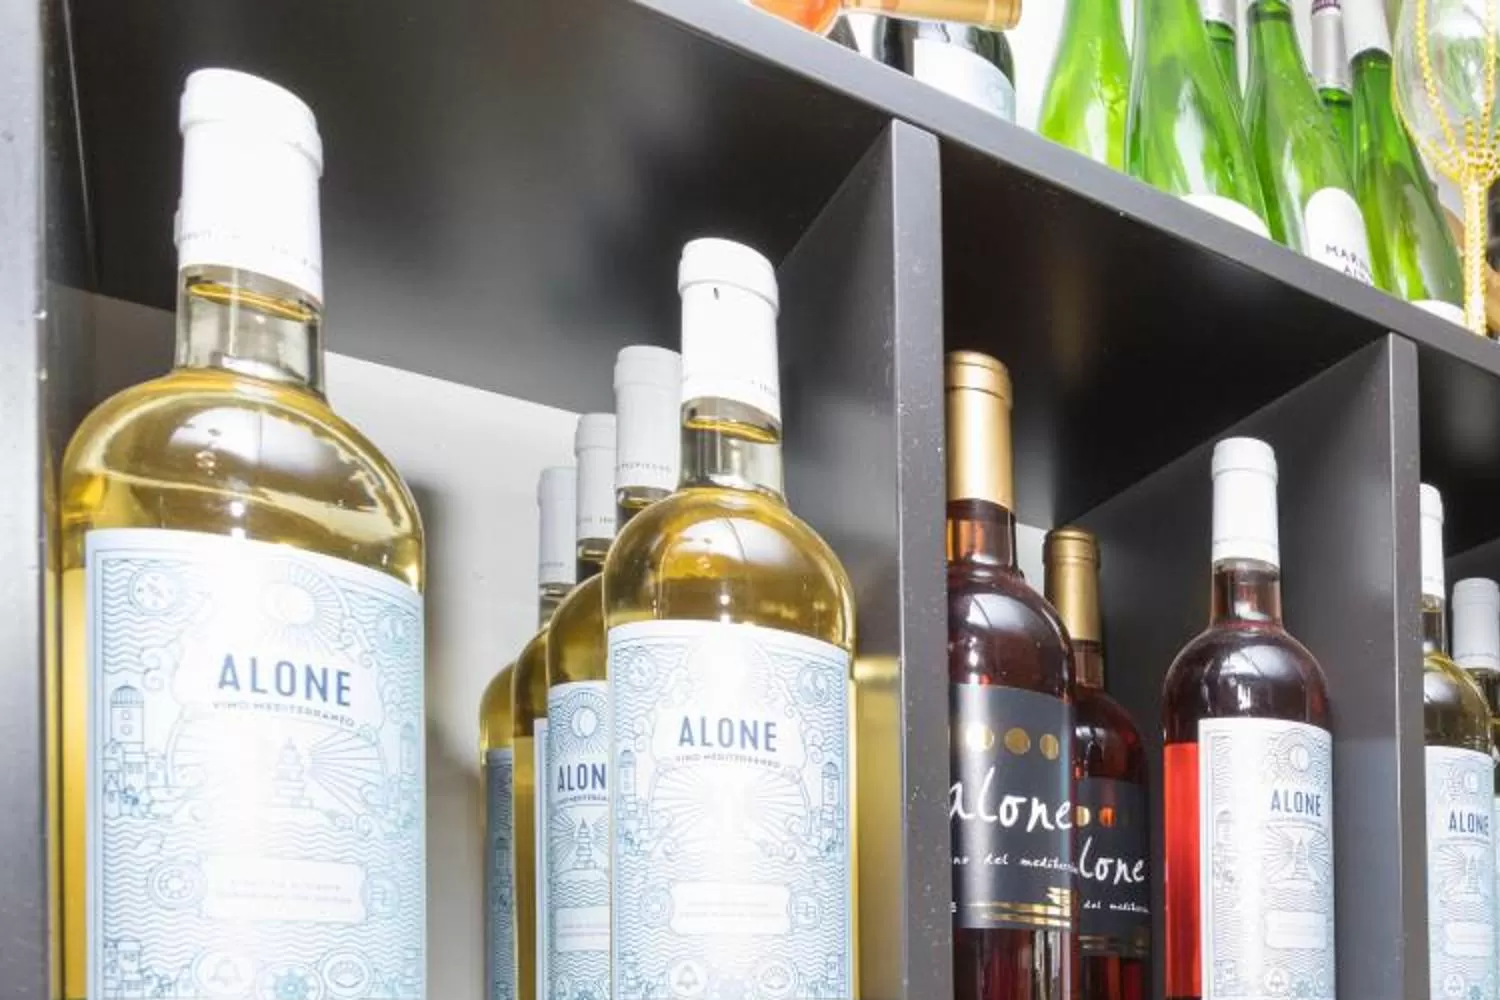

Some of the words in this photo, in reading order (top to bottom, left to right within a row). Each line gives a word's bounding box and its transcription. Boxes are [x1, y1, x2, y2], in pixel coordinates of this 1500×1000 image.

[218, 653, 351, 707] ALONE
[678, 715, 777, 752] ALONE
[558, 762, 606, 792] ALON
[950, 766, 1073, 833] alone
[1271, 789, 1321, 817] ALONE
[1448, 809, 1489, 838] ALONE
[1079, 835, 1145, 885] lone
